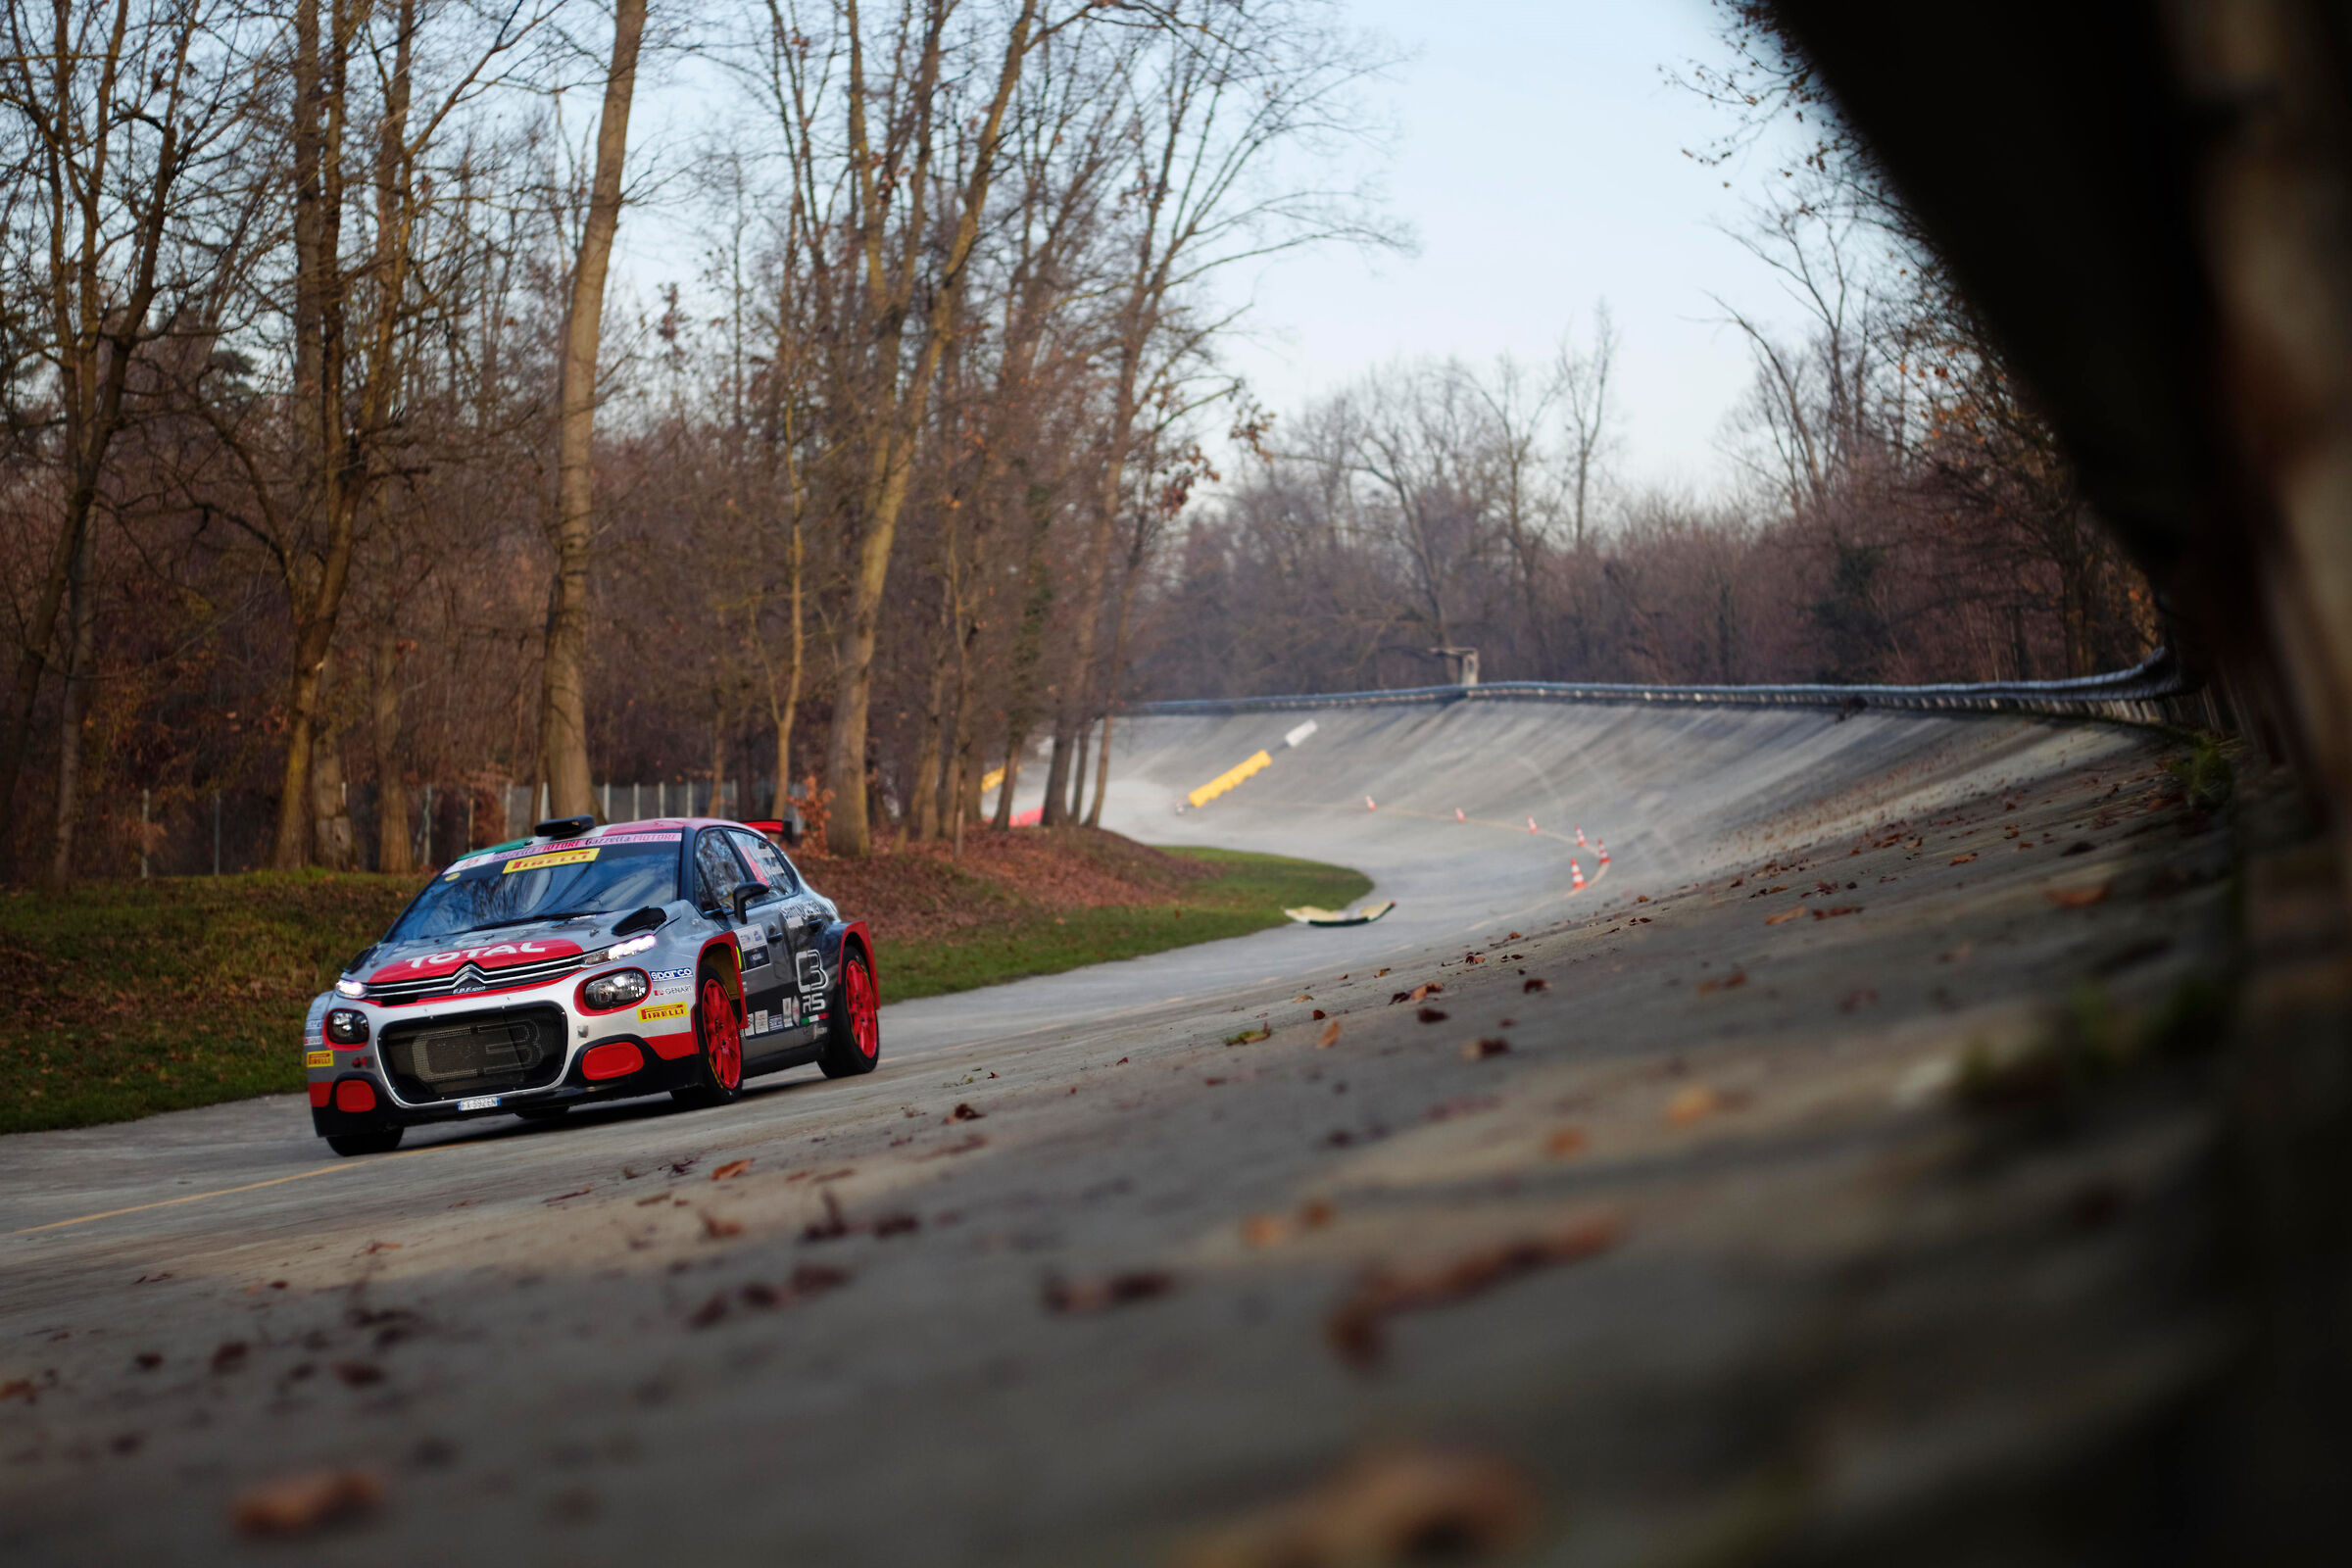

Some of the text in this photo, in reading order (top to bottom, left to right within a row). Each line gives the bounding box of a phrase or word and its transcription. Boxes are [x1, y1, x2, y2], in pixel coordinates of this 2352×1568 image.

[585, 835, 631, 846] Gazzetta
[512, 850, 590, 869] PIRELLI
[406, 943, 546, 968] TOTAL
[651, 968, 692, 980] sparco
[803, 993, 825, 1013] RS
[641, 1004, 684, 1020] PIRELLI
[308, 1053, 330, 1065] PIRELLI
